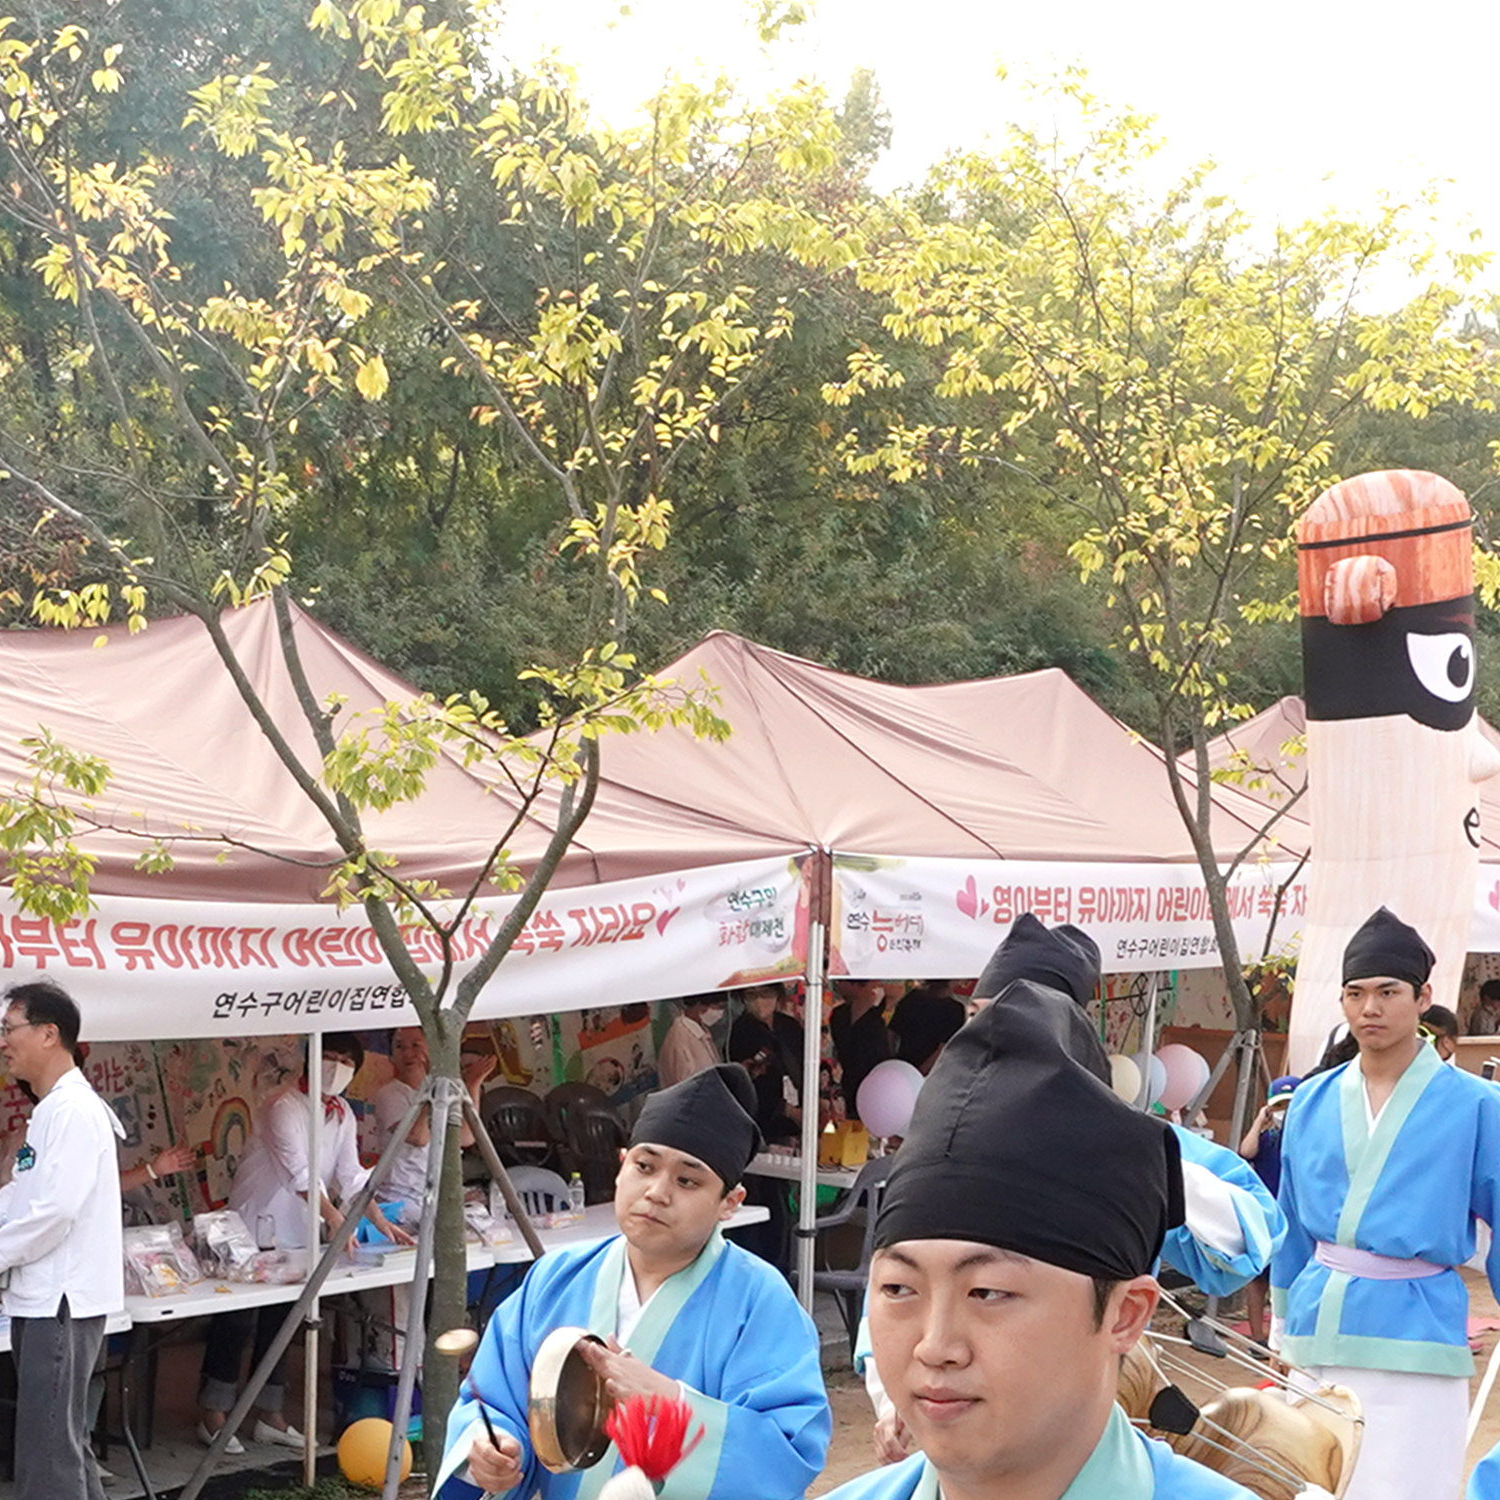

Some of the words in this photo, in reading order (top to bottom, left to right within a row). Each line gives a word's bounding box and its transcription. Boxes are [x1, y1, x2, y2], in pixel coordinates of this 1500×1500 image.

[727, 886, 778, 912] 연수구민
[992, 884, 1072, 924] 영아부터
[1078, 885, 1150, 924] 유아까지
[110, 920, 280, 971] 유아까지
[567, 902, 657, 949] 자라요
[718, 918, 750, 947] 화합
[749, 916, 785, 939] 대제전
[847, 911, 870, 933] 연수
[212, 983, 417, 1019] 연수구어린이집연합
